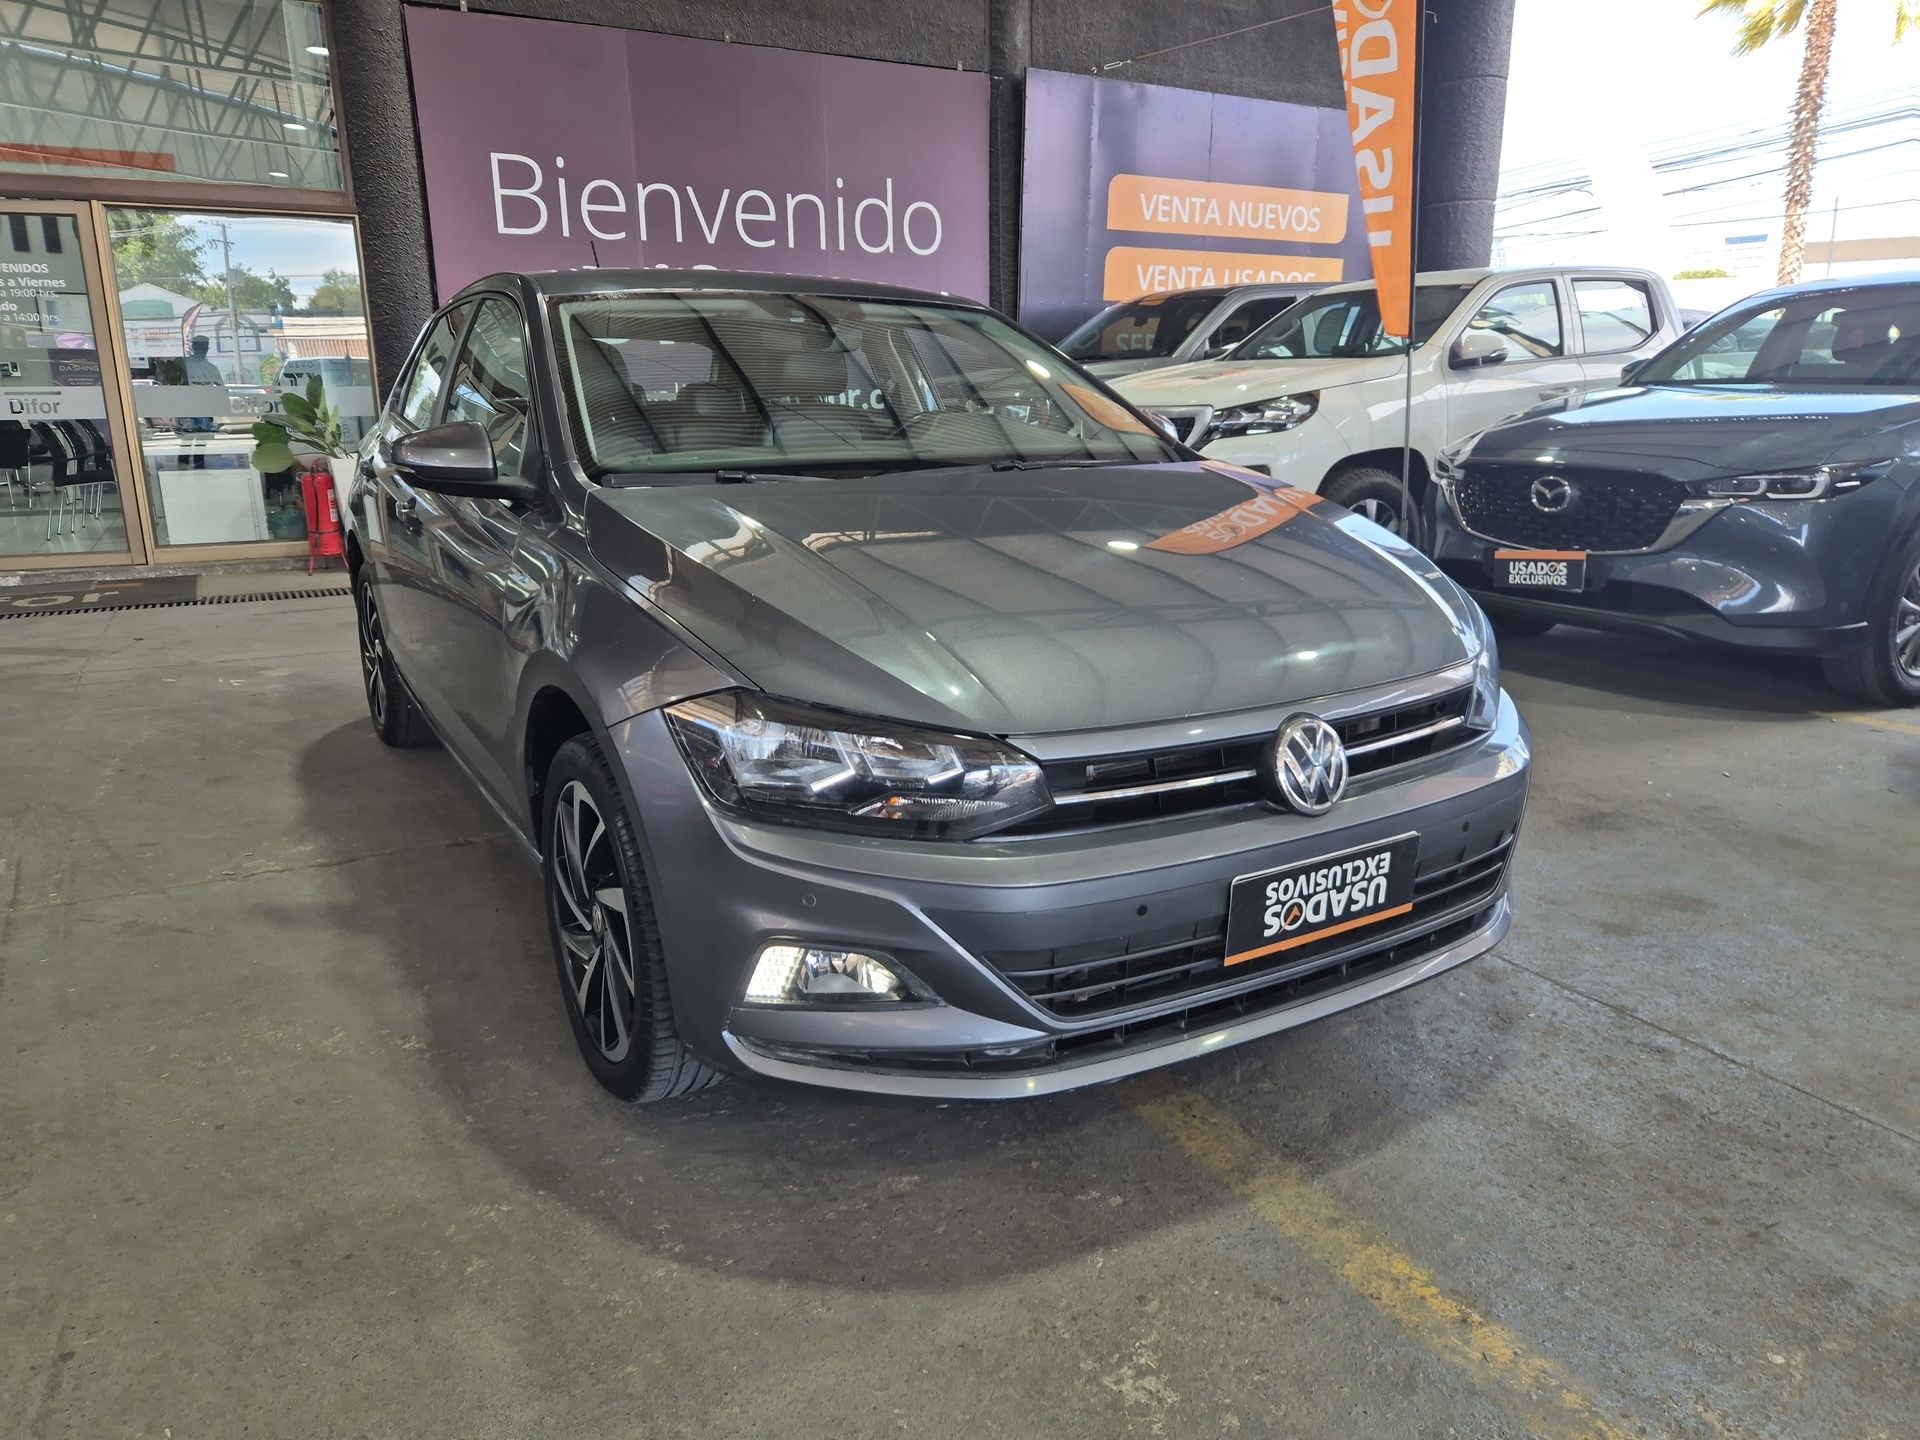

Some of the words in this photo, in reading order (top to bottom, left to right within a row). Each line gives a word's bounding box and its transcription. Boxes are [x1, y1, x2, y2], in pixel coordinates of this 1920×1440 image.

[490, 152, 943, 256] Bienvenido
[1140, 193, 1221, 226] VENTA
[1228, 200, 1321, 233] NUEVOS
[7, 278, 16, 287] a
[18, 276, 67, 287] Viernes
[1136, 264, 1216, 292] VENTA
[10, 288, 37, 298] 19:00
[13, 312, 40, 322] 14:00
[8, 399, 61, 415] Difor
[1509, 561, 1568, 576] USADOS
[1508, 574, 1567, 586] EXCLUSIVOS
[1265, 851, 1392, 906] EXCLUSIVOS
[1263, 875, 1388, 938] USADOS
